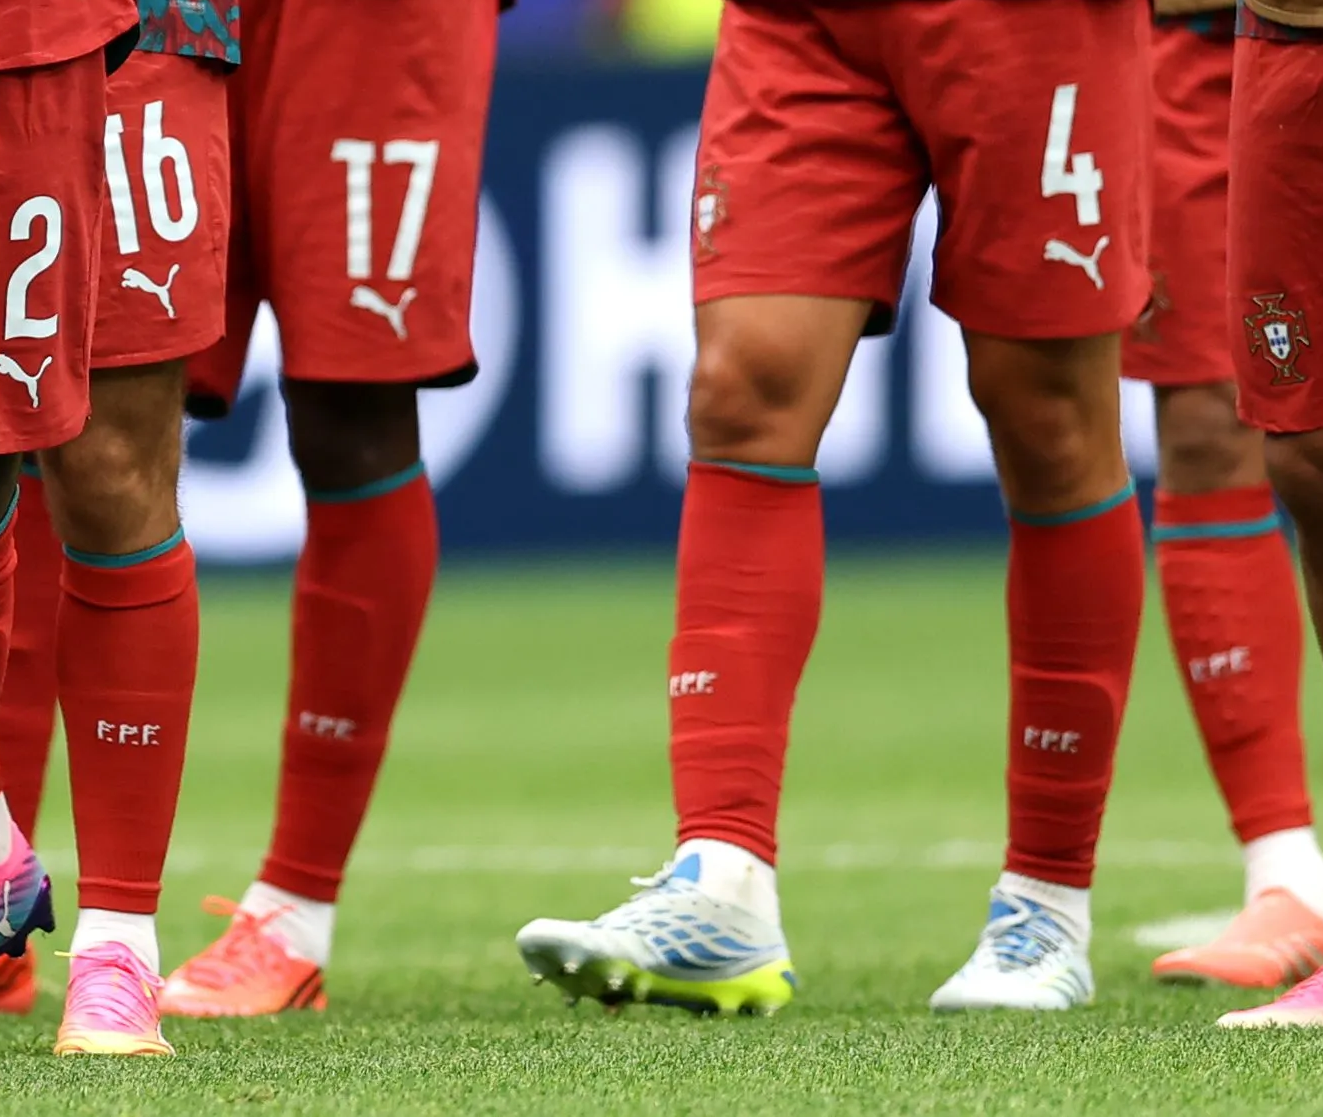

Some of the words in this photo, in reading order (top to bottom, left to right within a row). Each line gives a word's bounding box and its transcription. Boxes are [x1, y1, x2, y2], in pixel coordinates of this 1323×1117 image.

[104, 100, 199, 255] 16
[331, 139, 439, 280] 17
[1042, 84, 1103, 226] 4
[5, 195, 63, 341] 2
[96, 720, 161, 746] F.P.F.
